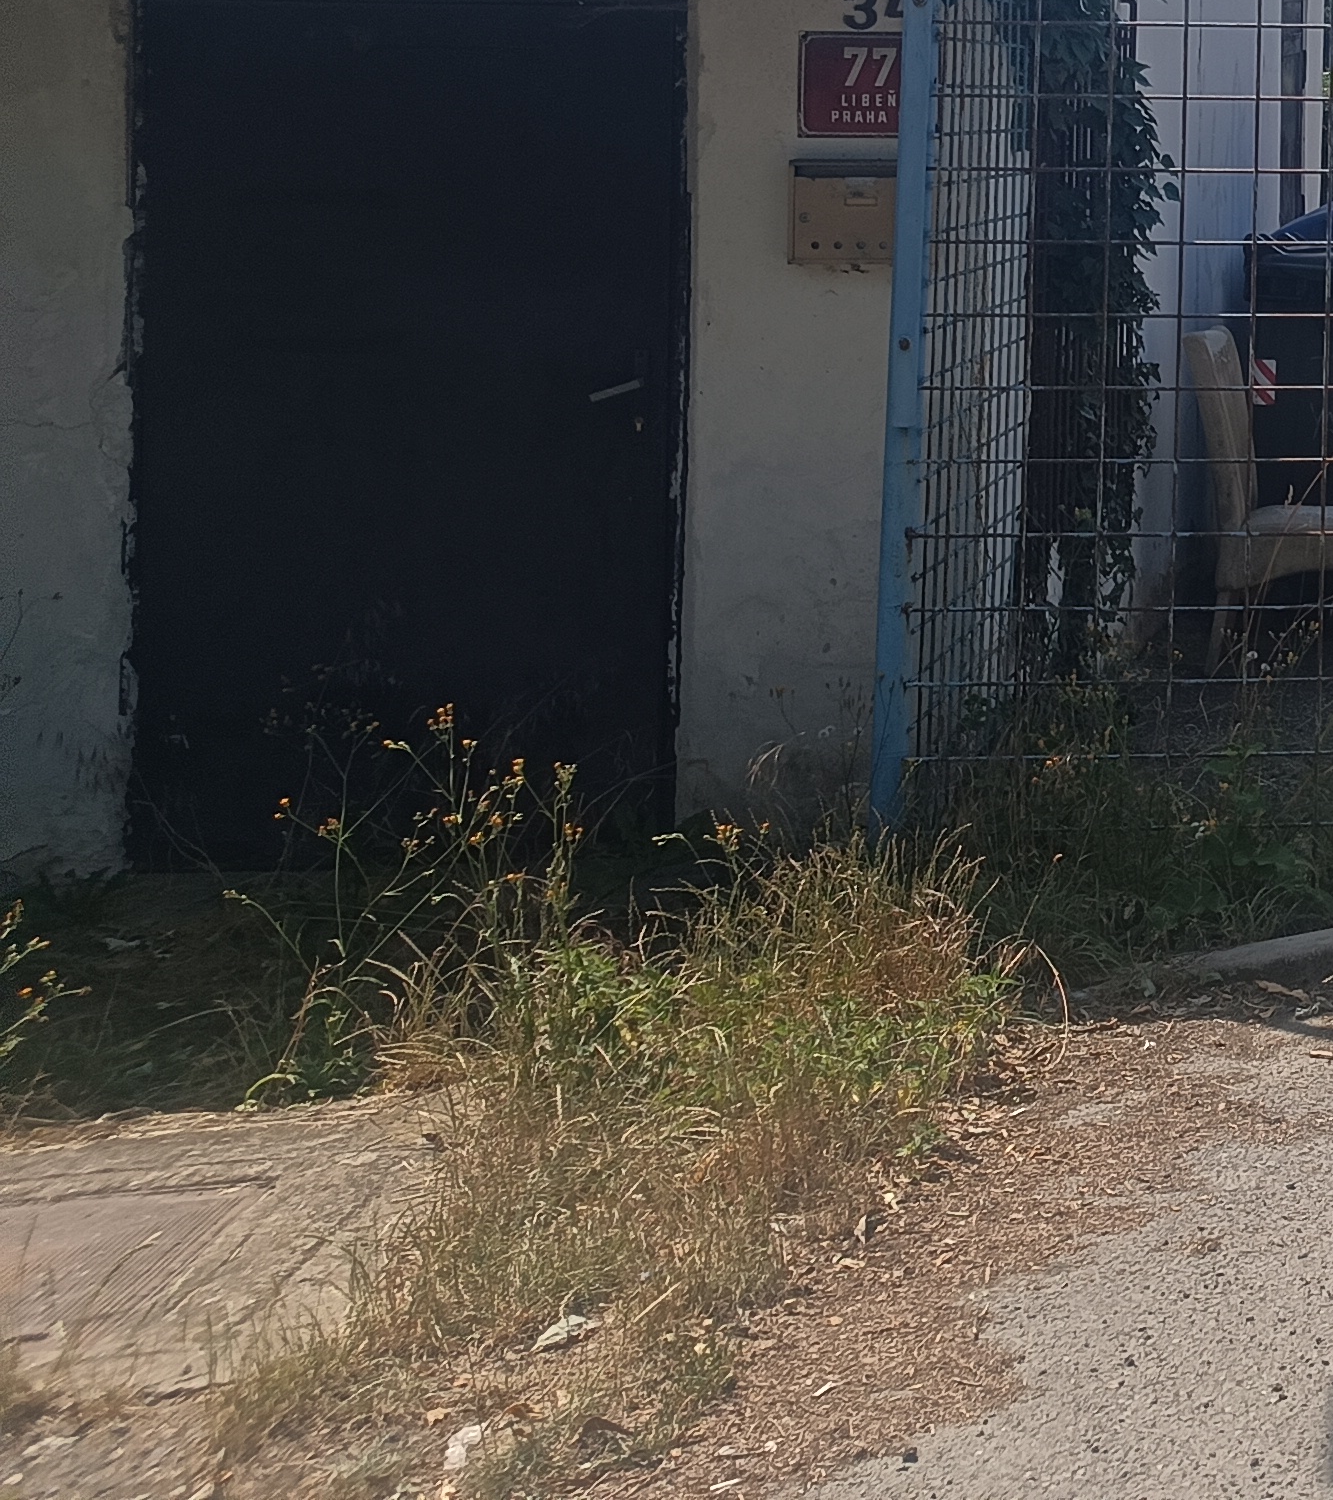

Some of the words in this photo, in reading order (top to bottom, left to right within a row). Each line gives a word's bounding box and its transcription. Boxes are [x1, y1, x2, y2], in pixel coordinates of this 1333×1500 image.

[843, 46, 898, 87] 77
[841, 90, 897, 107] LIBEŇ
[831, 110, 888, 124] PRAHA
